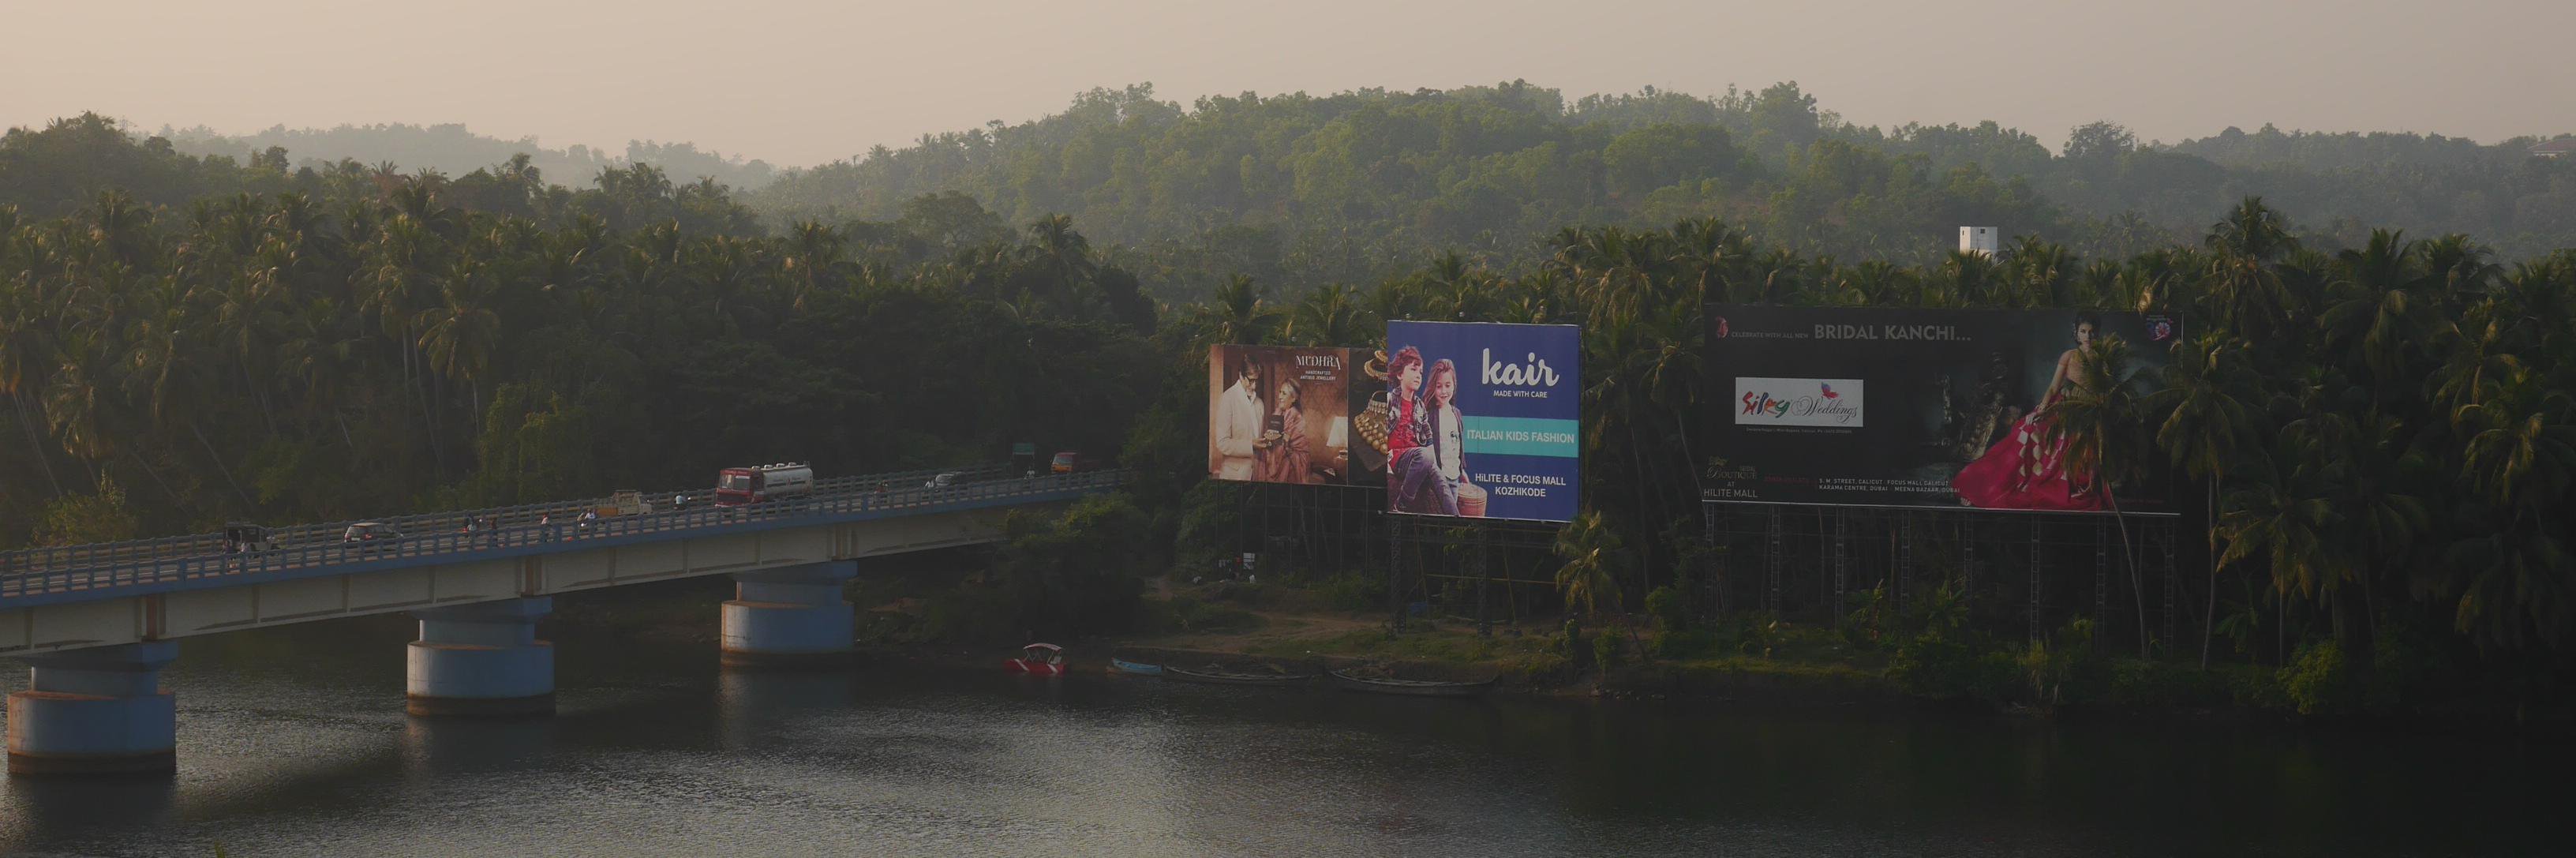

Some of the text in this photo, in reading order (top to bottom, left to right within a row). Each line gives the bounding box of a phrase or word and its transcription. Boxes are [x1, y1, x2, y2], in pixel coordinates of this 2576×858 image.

[1814, 324, 1878, 339] BRIDAL
[1885, 324, 1971, 340] KANCHI...
[1296, 355, 1341, 370] MUDHRA
[1482, 347, 1559, 387] kair
[1792, 395, 1857, 424] Weddings
[1467, 429, 1574, 444] ITALIAN KIDS FASHION
[1503, 474, 1509, 483] &
[1511, 474, 1540, 485] FOCUS
[1542, 476, 1567, 485] MALL
[1494, 486, 1546, 497] KOZHIKODE
[1704, 489, 1758, 498] HILITE MALL
